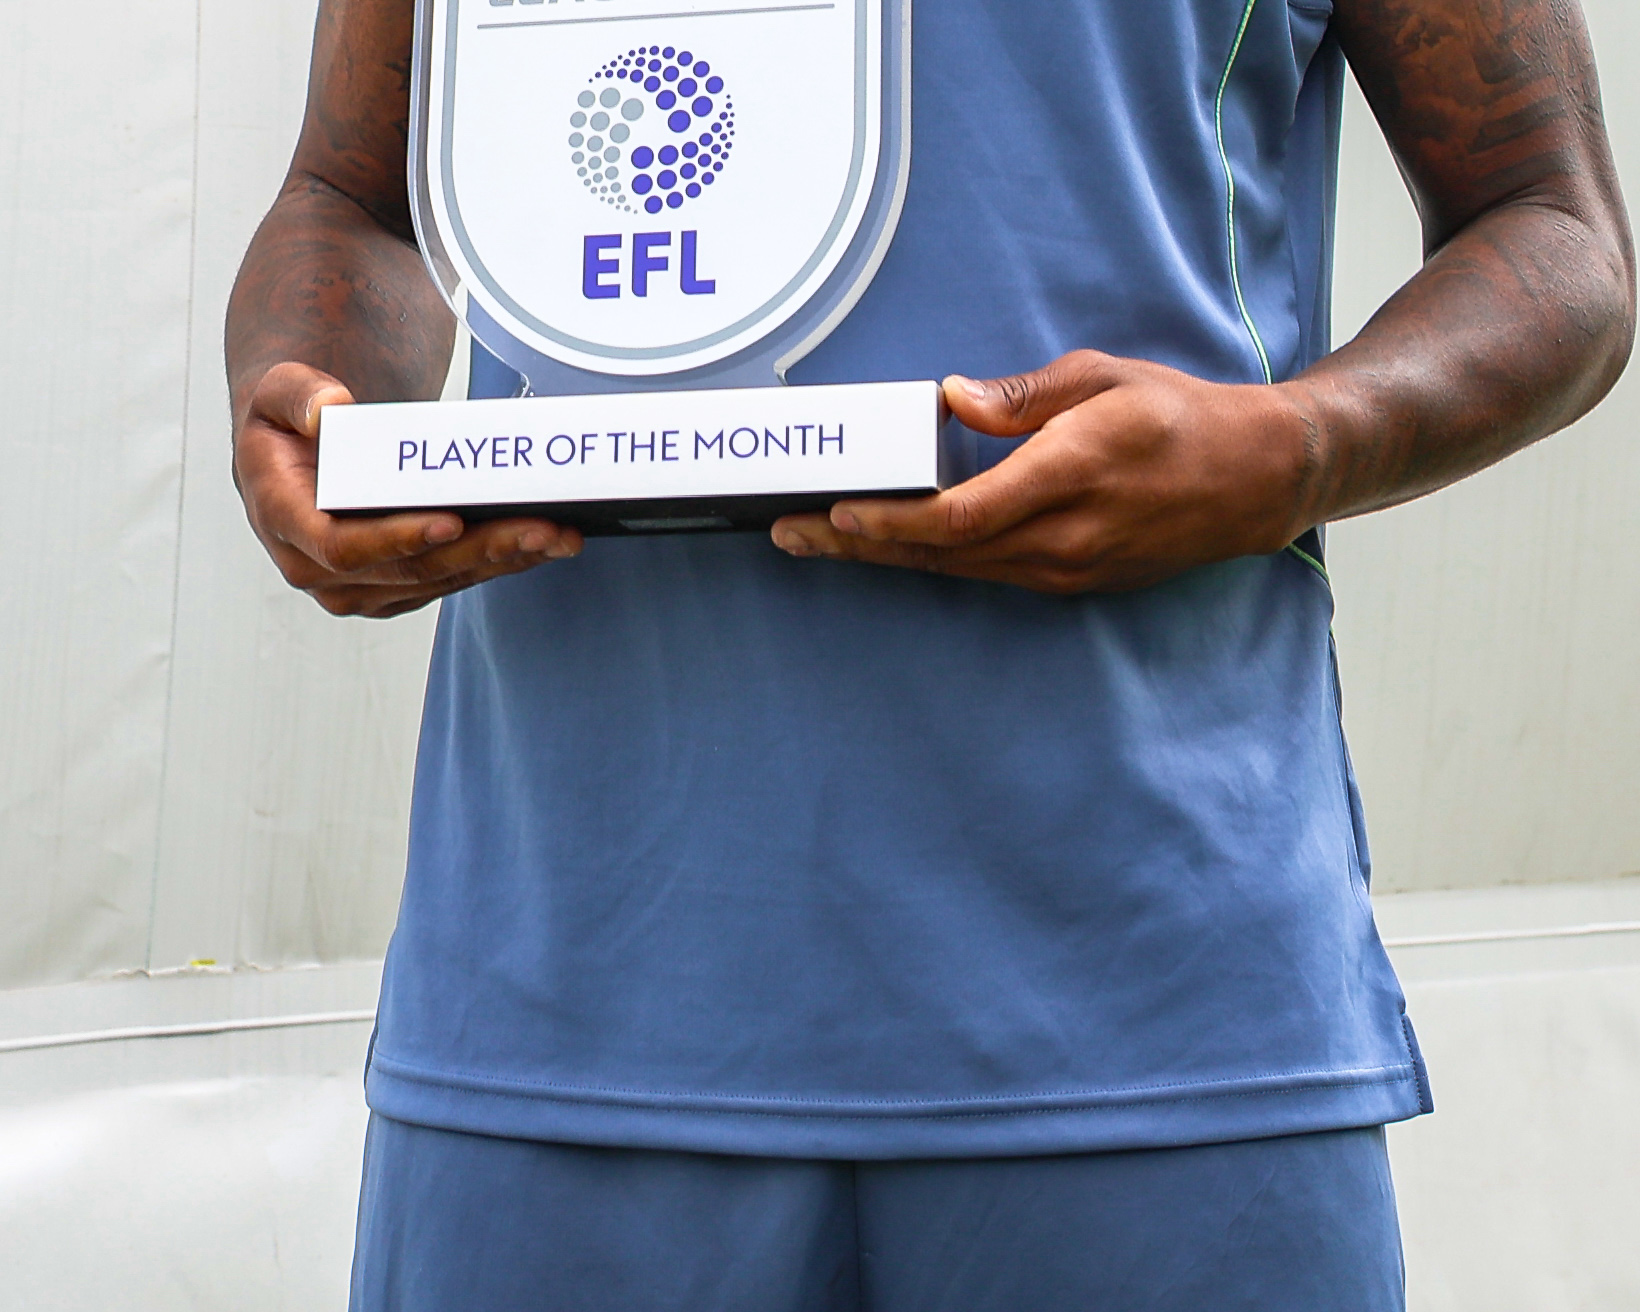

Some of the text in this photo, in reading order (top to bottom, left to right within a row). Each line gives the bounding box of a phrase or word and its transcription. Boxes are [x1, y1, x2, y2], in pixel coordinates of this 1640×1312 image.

[581, 229, 717, 300] EFL
[398, 423, 844, 471] PLAYER OF THE MONTH
